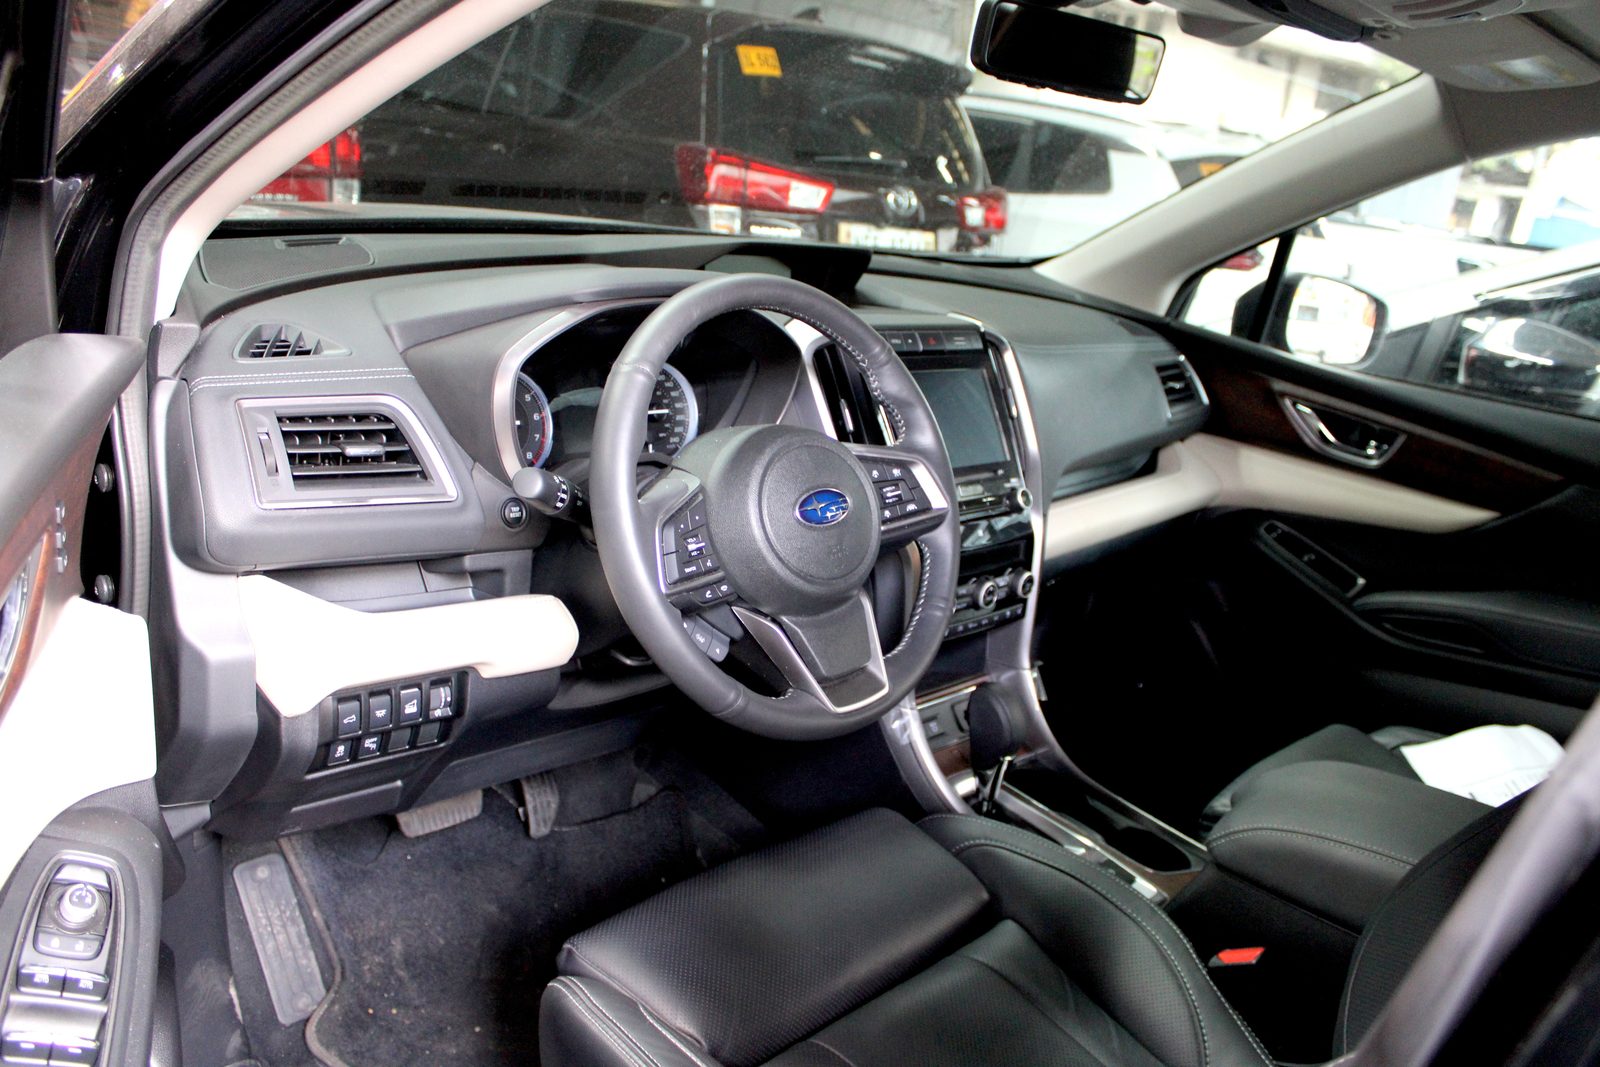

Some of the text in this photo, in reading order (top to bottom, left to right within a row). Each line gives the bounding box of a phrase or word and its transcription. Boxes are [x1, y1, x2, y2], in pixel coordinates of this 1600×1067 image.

[524, 394, 531, 402] 5
[533, 413, 540, 421] 6
[526, 452, 533, 460] 8
[33, 973, 50, 984] AUTO
[78, 979, 94, 990] AUTO
